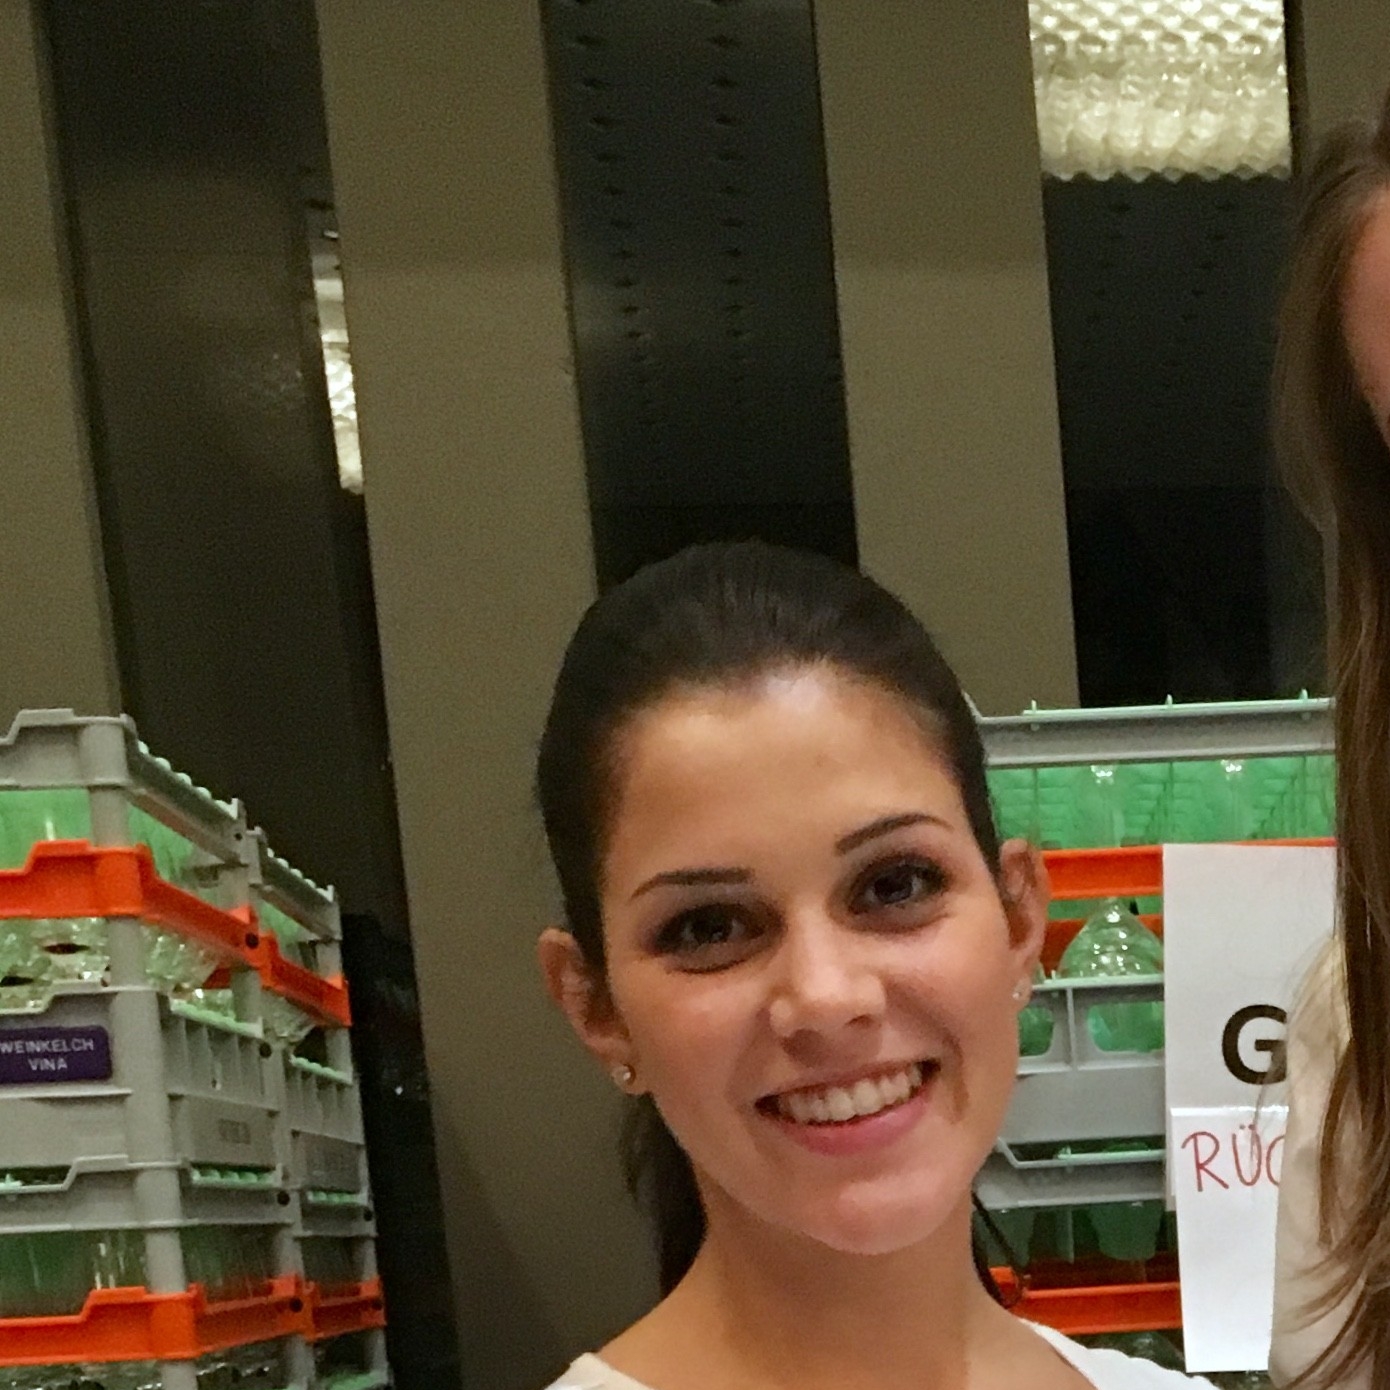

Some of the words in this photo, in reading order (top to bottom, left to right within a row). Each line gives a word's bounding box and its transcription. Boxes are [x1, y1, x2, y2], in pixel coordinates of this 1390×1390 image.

[0, 1038, 94, 1053] WEINKELCH
[1222, 1004, 1288, 1085] G
[28, 1058, 68, 1071] VINA
